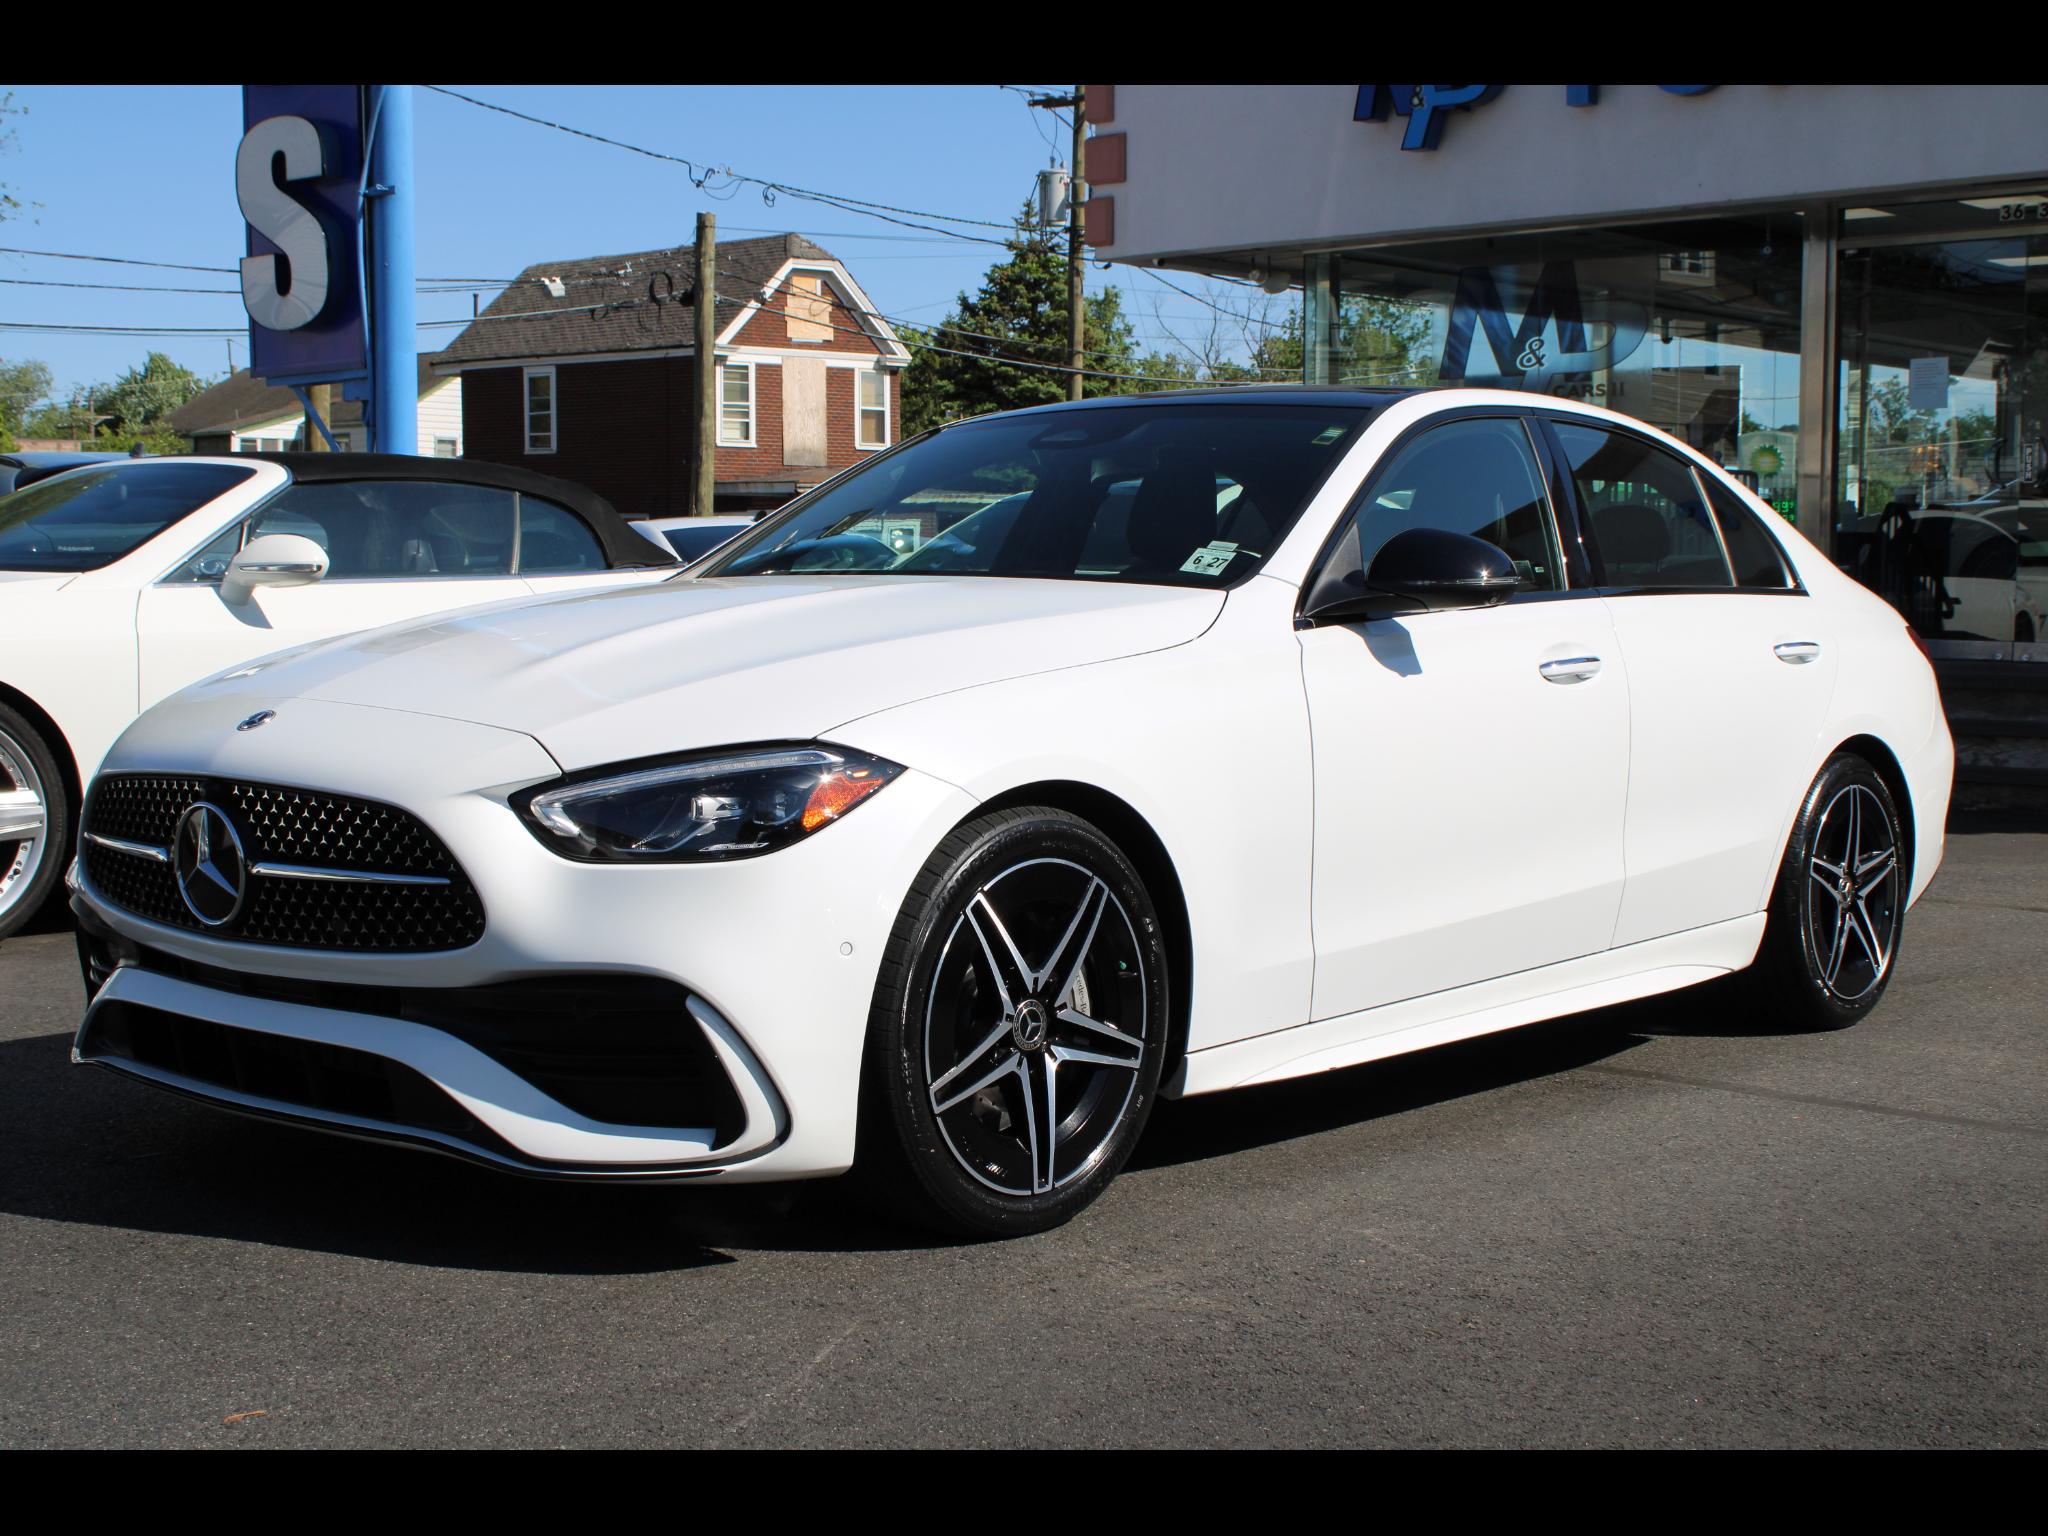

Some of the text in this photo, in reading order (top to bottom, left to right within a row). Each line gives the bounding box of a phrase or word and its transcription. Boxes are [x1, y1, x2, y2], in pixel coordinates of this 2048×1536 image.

[236, 115, 330, 331] S
[1552, 383, 1607, 398] CARS
[1193, 556, 1229, 568] 6 27
